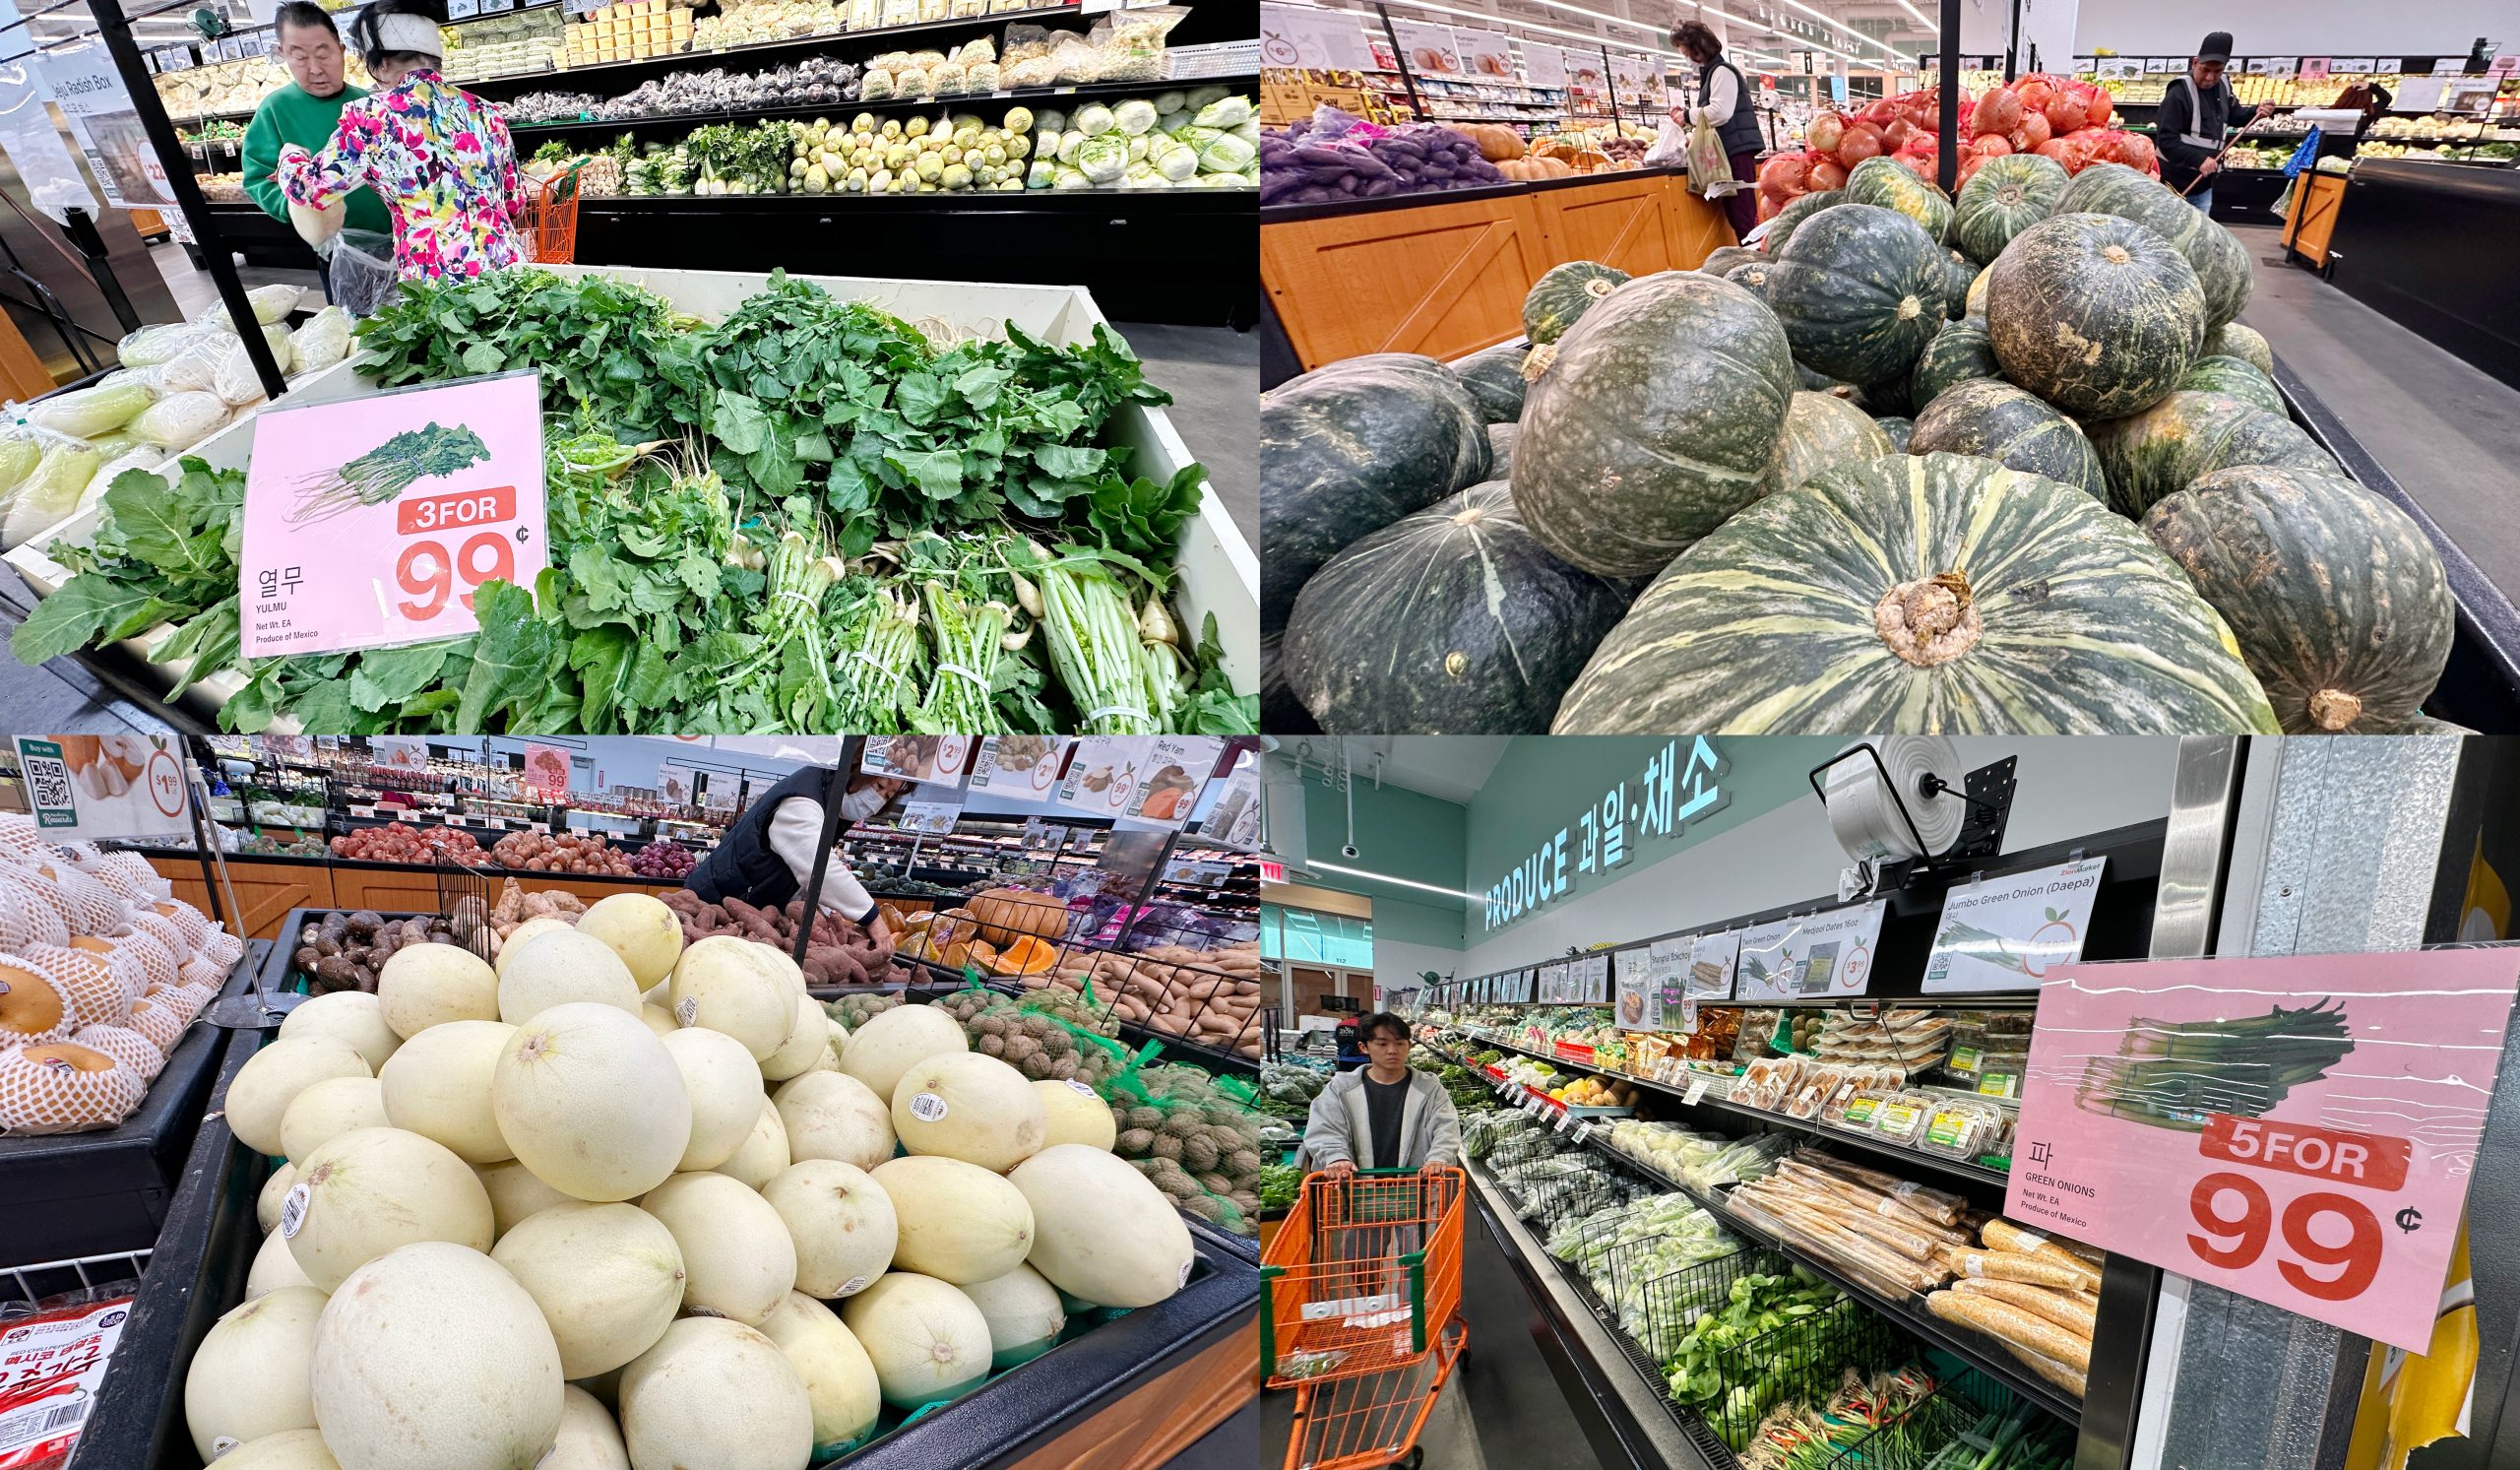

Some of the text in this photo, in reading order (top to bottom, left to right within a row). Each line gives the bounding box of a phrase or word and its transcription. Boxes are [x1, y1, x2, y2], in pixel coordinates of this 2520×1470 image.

[67, 77, 93, 97] Radish
[94, 74, 113, 91] Box
[259, 566, 304, 599] 열무
[256, 602, 287, 613] YULMU
[256, 622, 268, 631] Net
[282, 619, 291, 628] EA
[256, 629, 319, 644] Produce of Mexico
[1158, 740, 1185, 755] Red Yam
[1485, 827, 1568, 930] PRODUCE
[1948, 875, 2095, 911] Jumbo Green Onion (Daepa)
[1802, 919, 1858, 935] Medjool Dates 16oz
[1767, 932, 1781, 941] Onion
[2028, 1141, 2053, 1171] 파
[2025, 1172, 2096, 1198] GREEN ONIONS
[2022, 1188, 2059, 1206] Net Wt. EA
[2020, 1200, 2049, 1216] Produce
[2059, 1212, 2087, 1228] Mexico
[76, 1329, 104, 1342] POWDER
[5, 1350, 55, 1366] 멕시코
